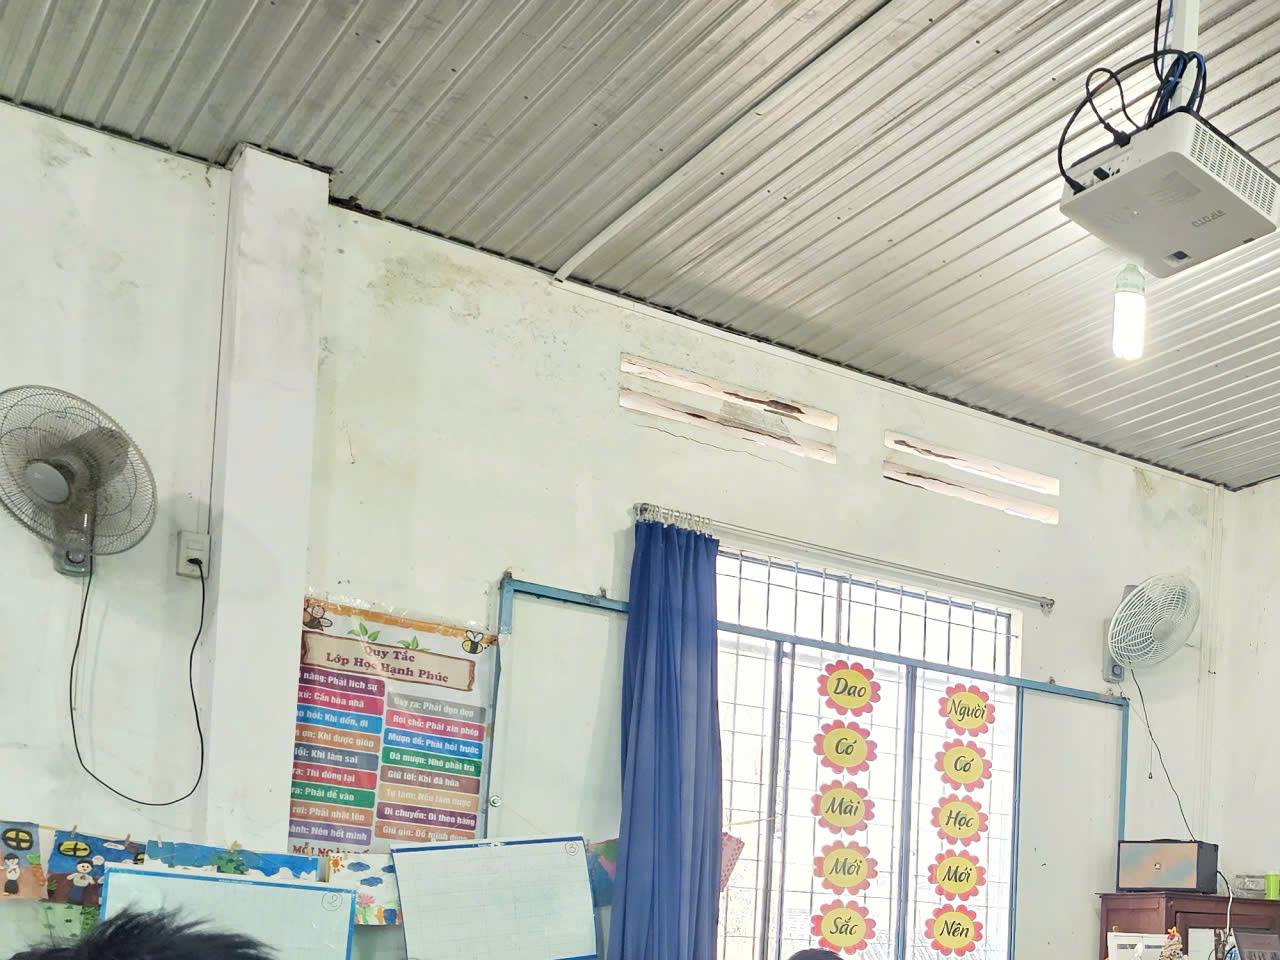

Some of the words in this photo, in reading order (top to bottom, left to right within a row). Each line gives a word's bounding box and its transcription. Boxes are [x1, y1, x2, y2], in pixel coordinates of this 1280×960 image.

[365, 646, 389, 660] Quy
[393, 650, 415, 662] Tắc
[326, 652, 349, 666] Lớp
[353, 657, 377, 671] Học
[380, 663, 414, 677] Hạnh
[418, 669, 449, 682] Phúc
[833, 677, 867, 698] Dao
[948, 699, 988, 723] Người
[835, 737, 857, 757] Có
[954, 754, 975, 774] Có
[825, 796, 861, 817] Mài
[945, 810, 974, 832] Học
[829, 857, 861, 878] Mới
[942, 863, 973, 884] Mới
[830, 916, 859, 937] Sắc
[940, 919, 970, 940] Nên
